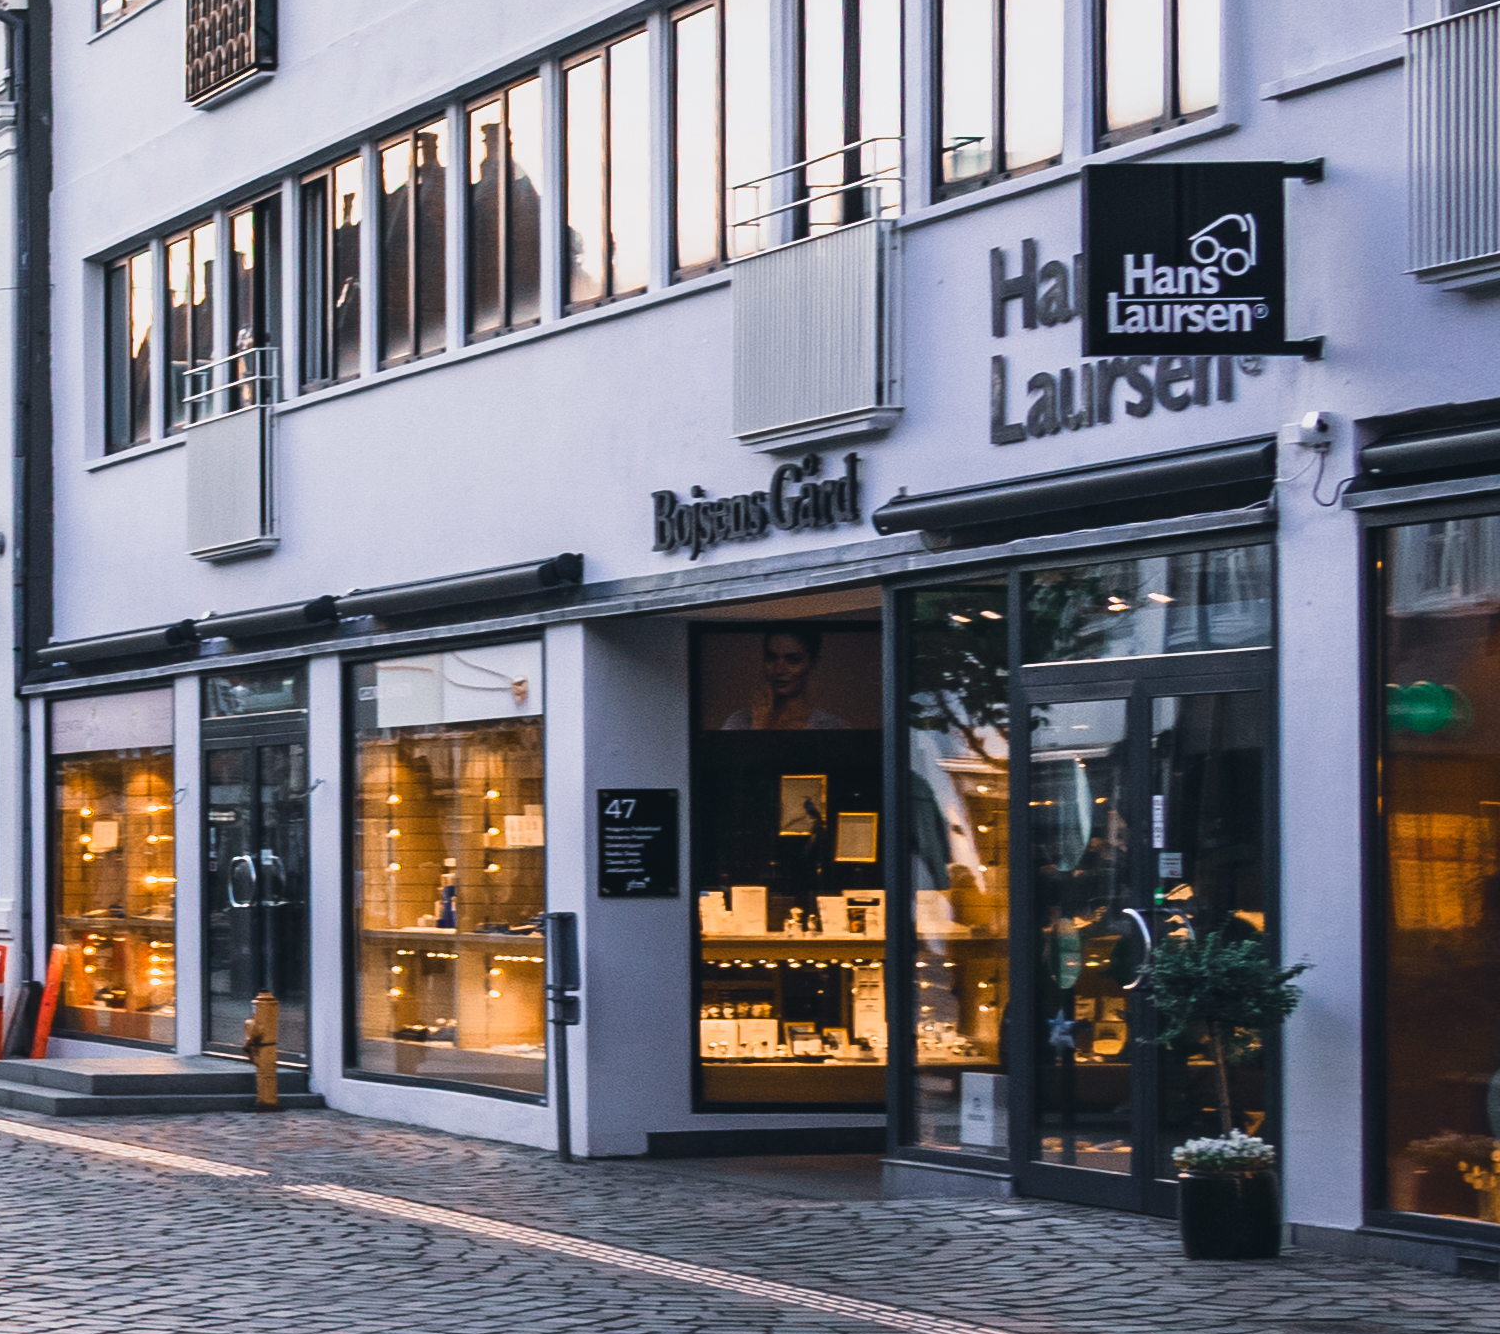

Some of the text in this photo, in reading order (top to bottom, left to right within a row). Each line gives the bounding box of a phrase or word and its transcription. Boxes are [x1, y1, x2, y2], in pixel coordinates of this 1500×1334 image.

[990, 237, 1087, 338] Ha
[1123, 253, 1220, 295] Hans
[651, 452, 866, 560] Bojsens Gård
[604, 799, 637, 819] 47
